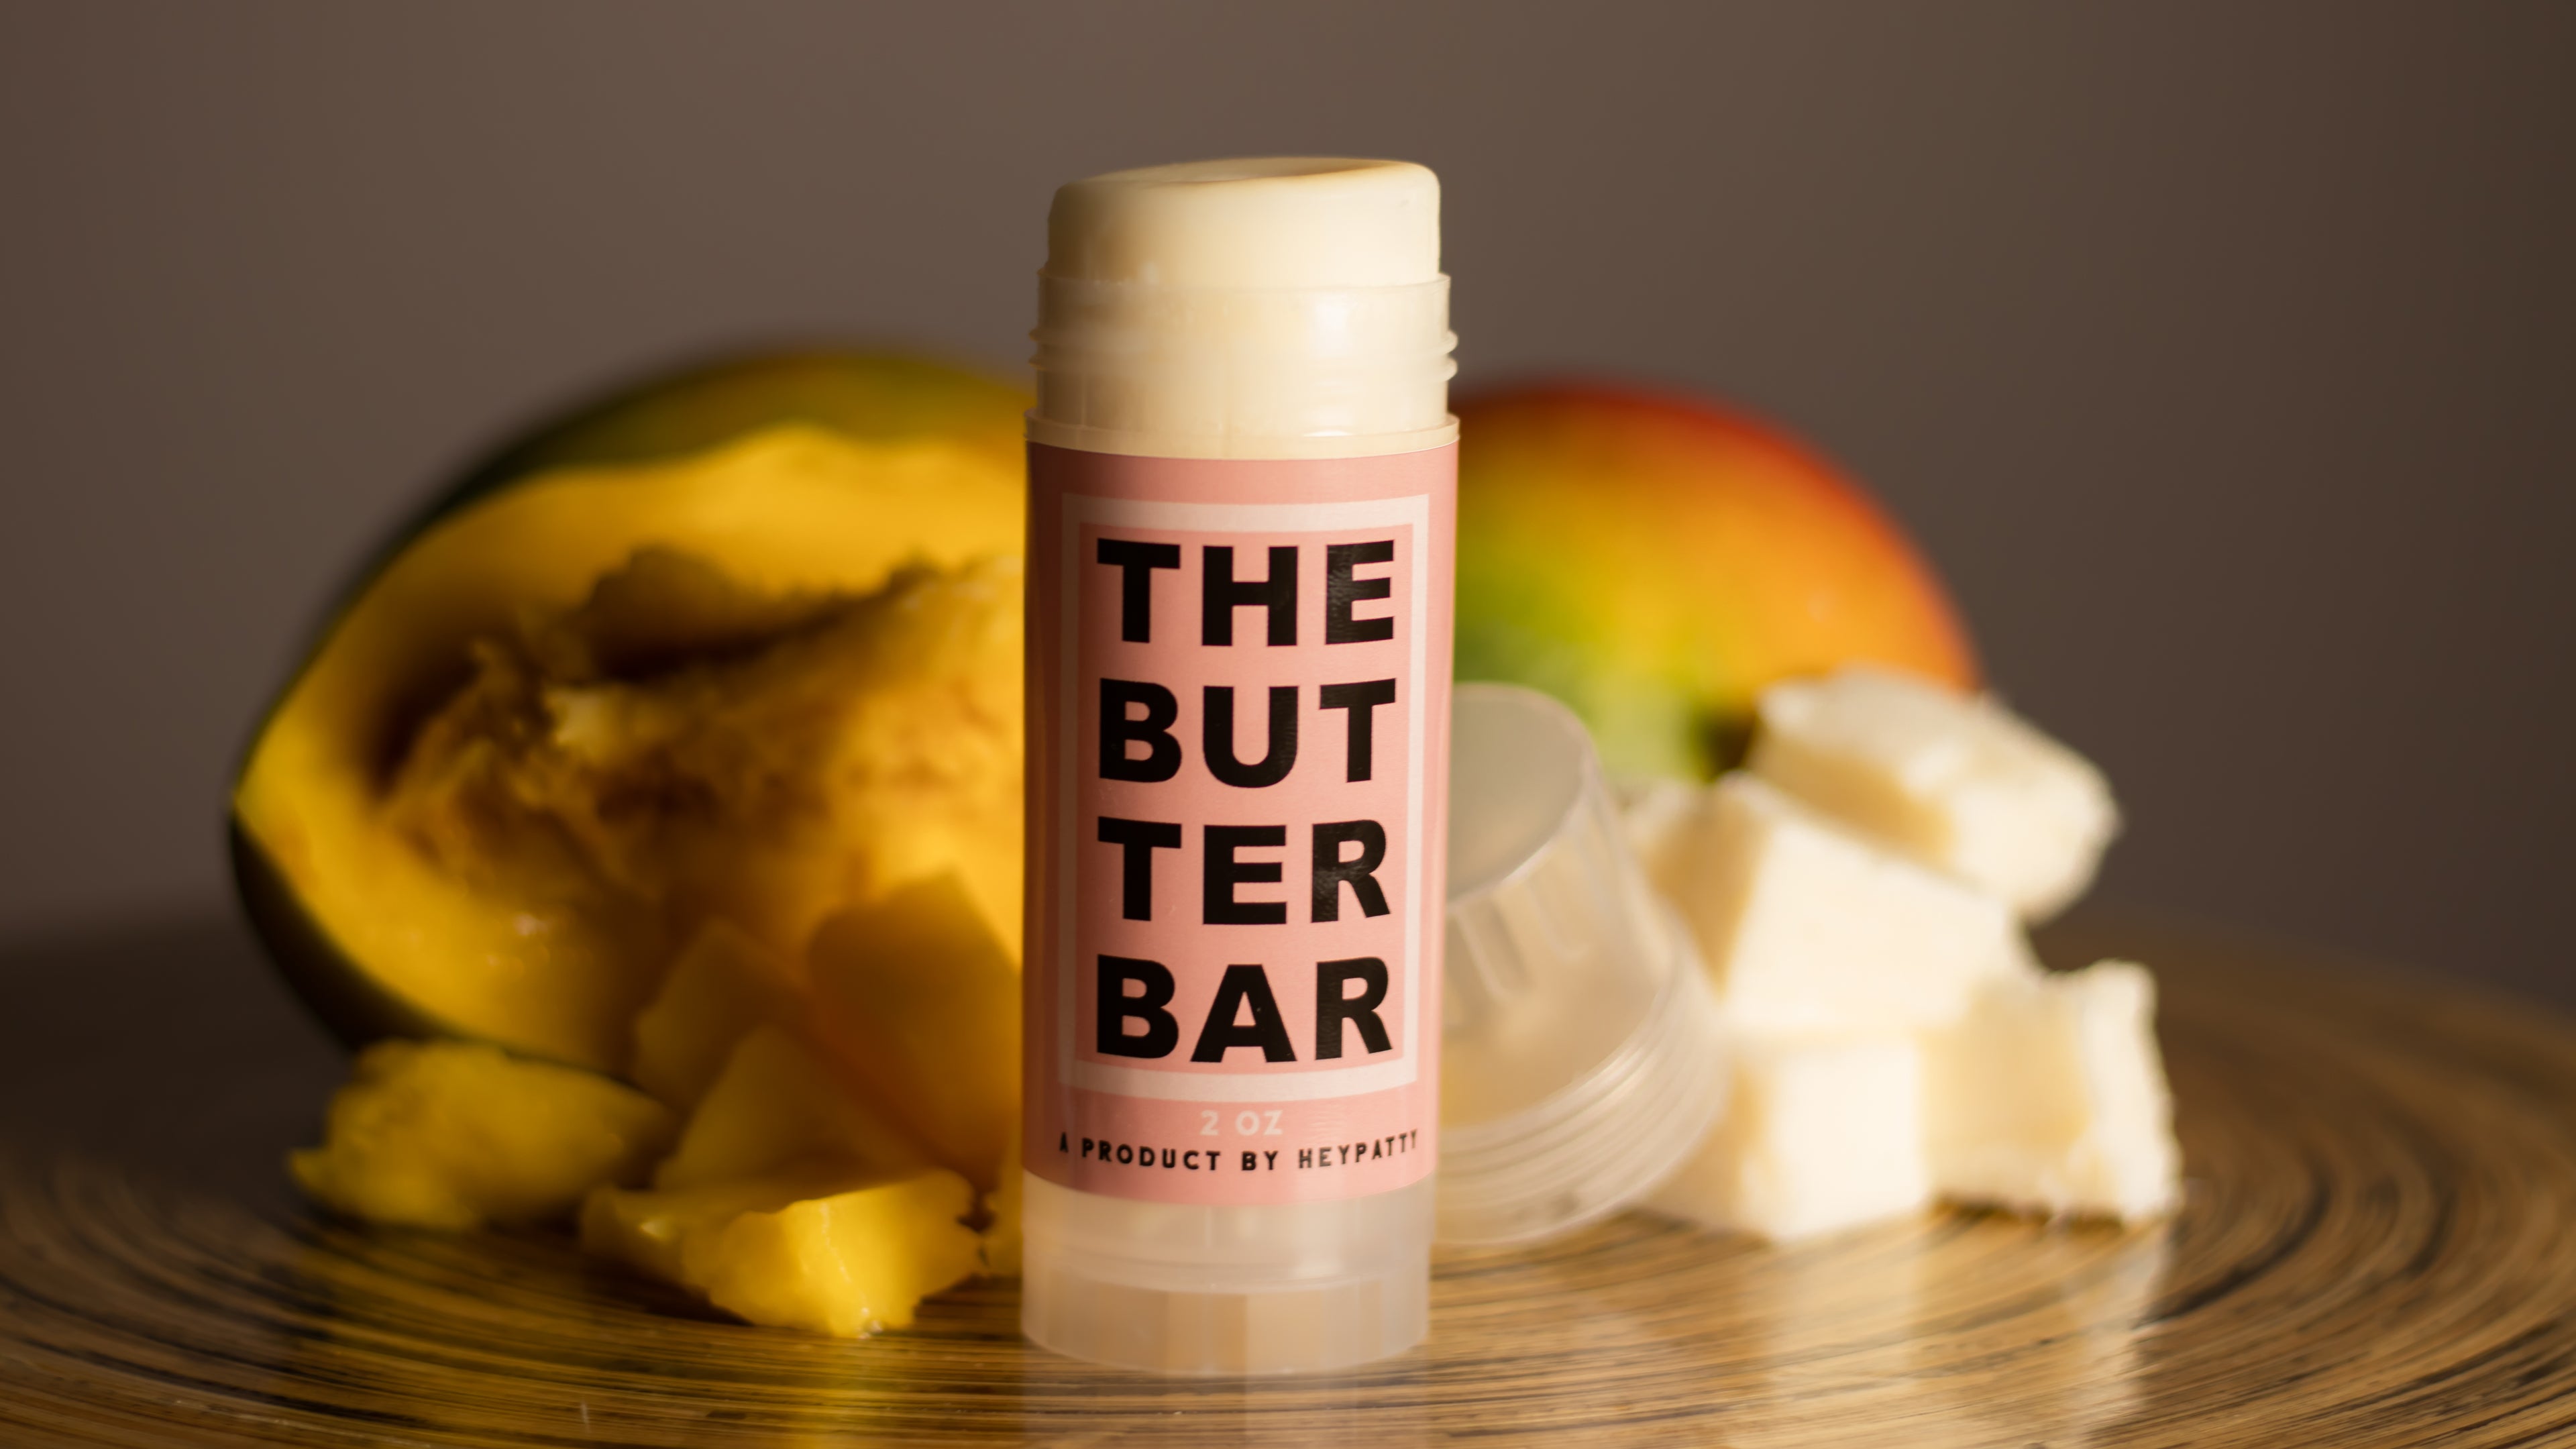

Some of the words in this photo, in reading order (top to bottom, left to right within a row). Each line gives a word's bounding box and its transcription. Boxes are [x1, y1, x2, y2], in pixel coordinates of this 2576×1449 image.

[1097, 538, 1395, 647] THE
[1099, 678, 1397, 788] BUT
[1097, 816, 1392, 925] TER
[1096, 954, 1393, 1063] BAR
[1059, 1132, 1069, 1153] A
[1081, 1137, 1221, 1171] PRODUCT
[1241, 1150, 1279, 1171] BY
[1298, 1129, 1419, 1169] HEYPATTY
[1199, 1110, 1220, 1136] 2
[1235, 1110, 1283, 1136] OZ
